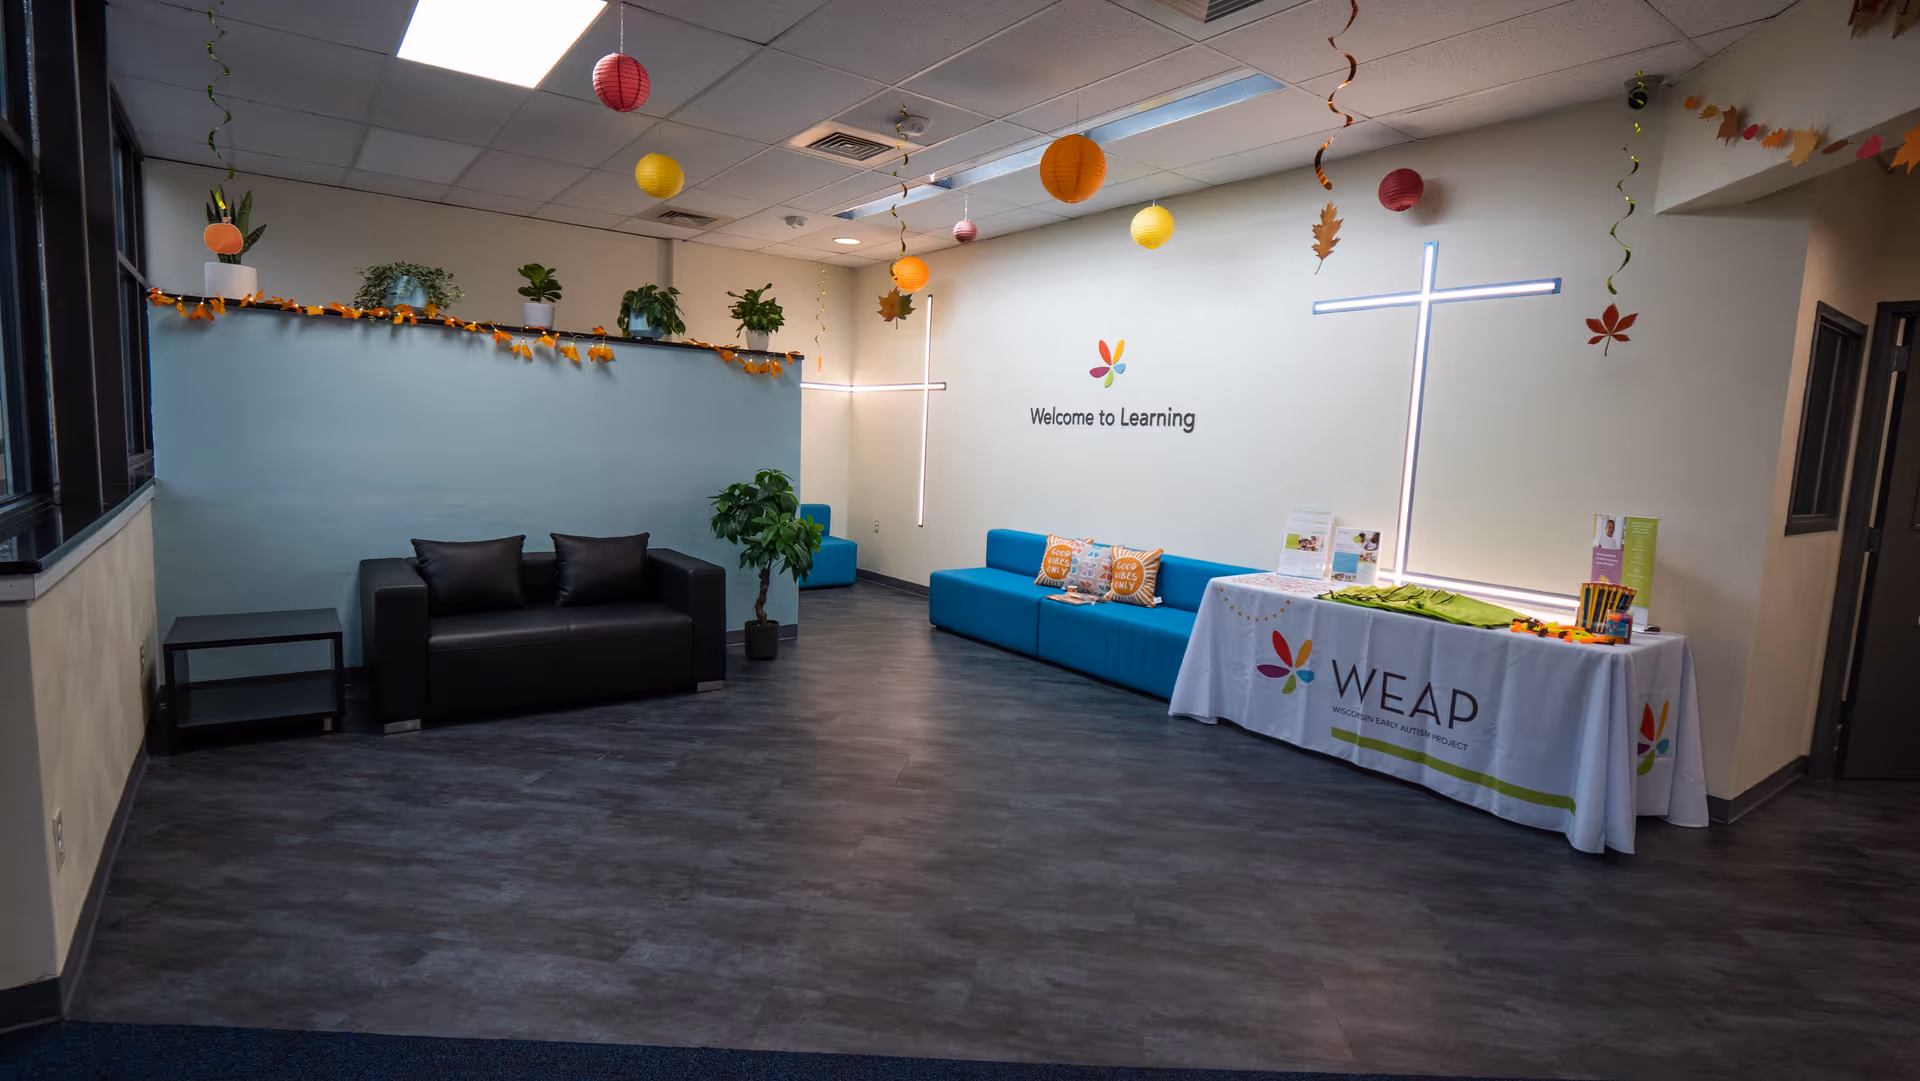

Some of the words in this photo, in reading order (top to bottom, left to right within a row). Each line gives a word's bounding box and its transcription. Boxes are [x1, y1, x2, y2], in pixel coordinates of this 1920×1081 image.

[1030, 406, 1094, 426] Welcome
[1099, 409, 1115, 426] to
[1120, 407, 1196, 433] Learning
[1051, 548, 1071, 557] GOOD
[1047, 557, 1070, 567] VIBES
[1117, 562, 1137, 571] GOOD
[1046, 566, 1068, 575] ONLY
[1115, 571, 1138, 581] VIBES
[1114, 581, 1136, 590] ONLY
[1332, 659, 1479, 729] WEAP
[1375, 717, 1399, 729] EARLY
[1400, 724, 1431, 739] AUTISM
[1432, 733, 1469, 751] PROJECT
